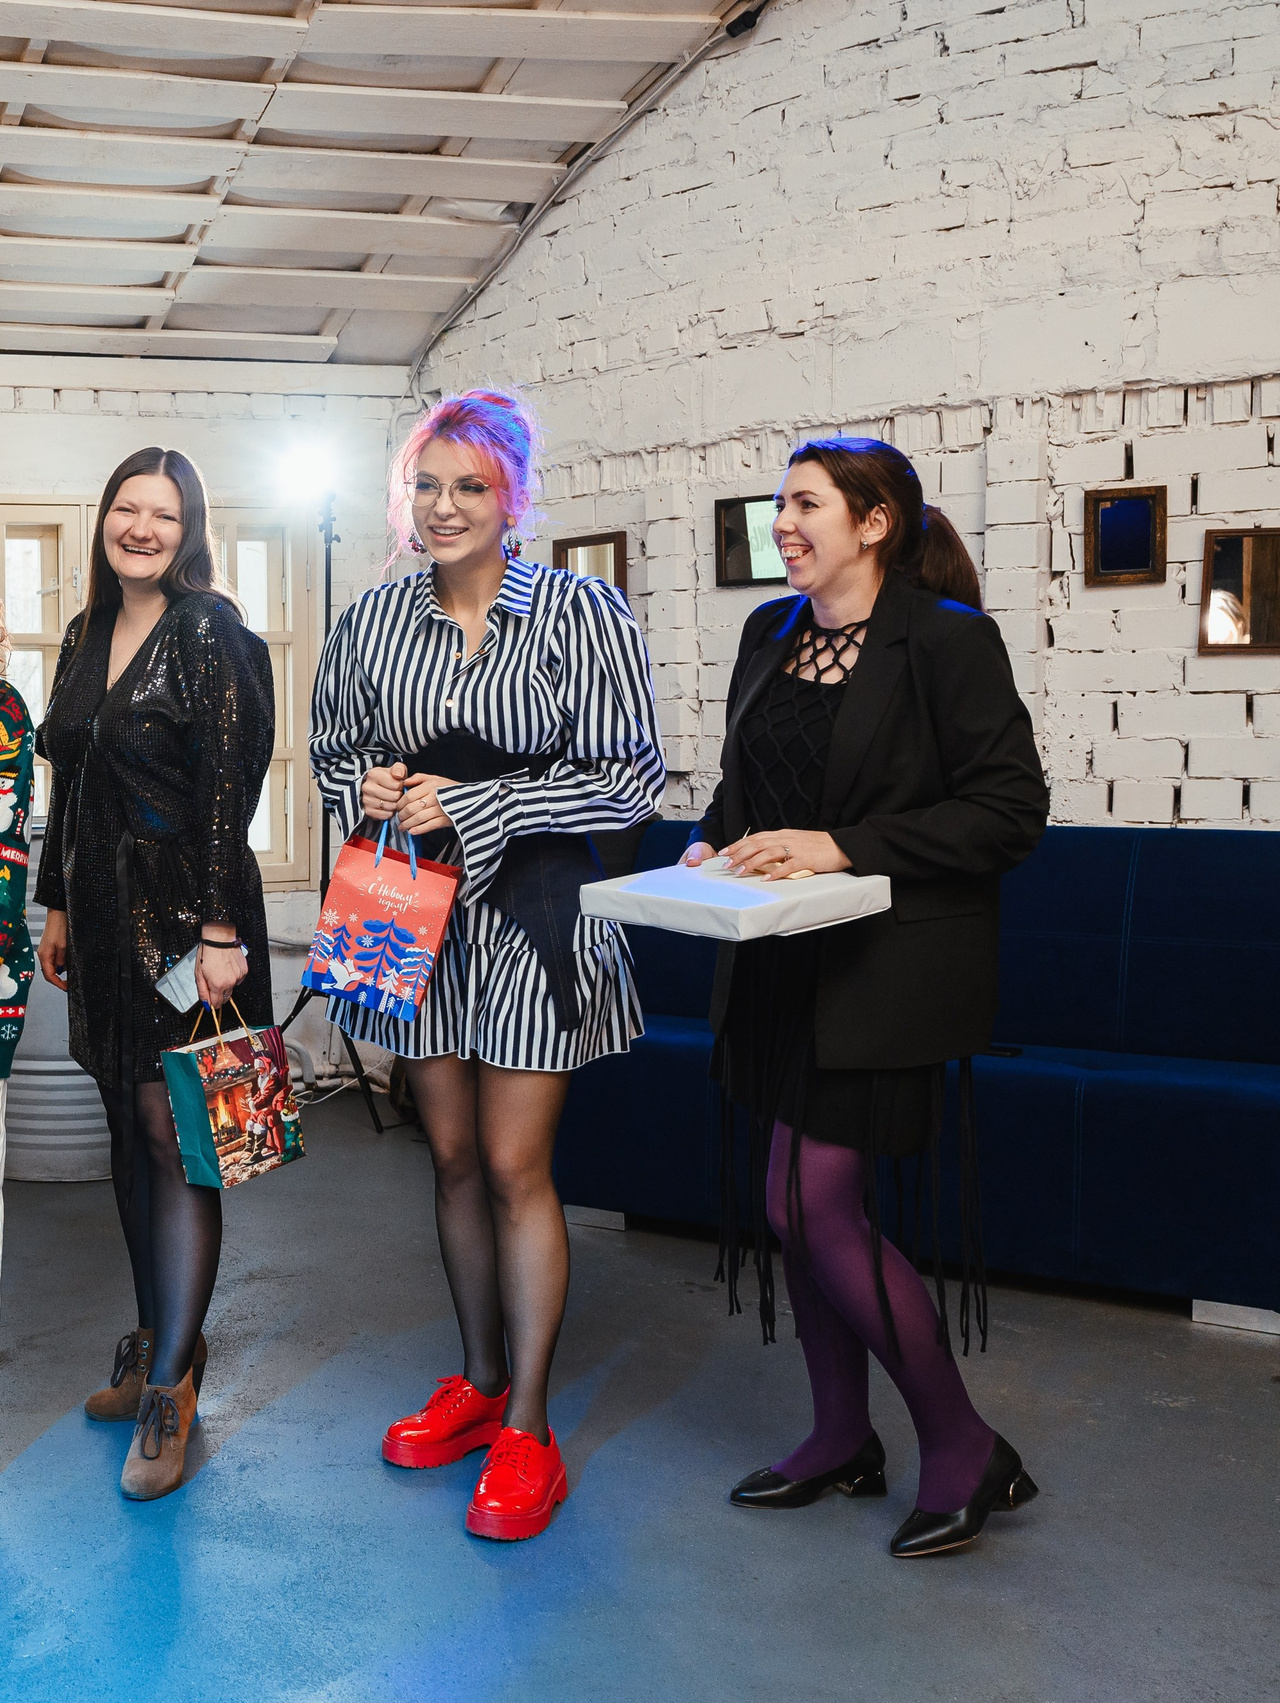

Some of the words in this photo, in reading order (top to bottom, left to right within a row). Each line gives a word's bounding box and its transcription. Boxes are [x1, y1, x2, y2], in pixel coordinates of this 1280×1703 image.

[367, 882, 378, 895] С
[377, 883, 414, 906] Новым
[378, 897, 409, 915] годом!
